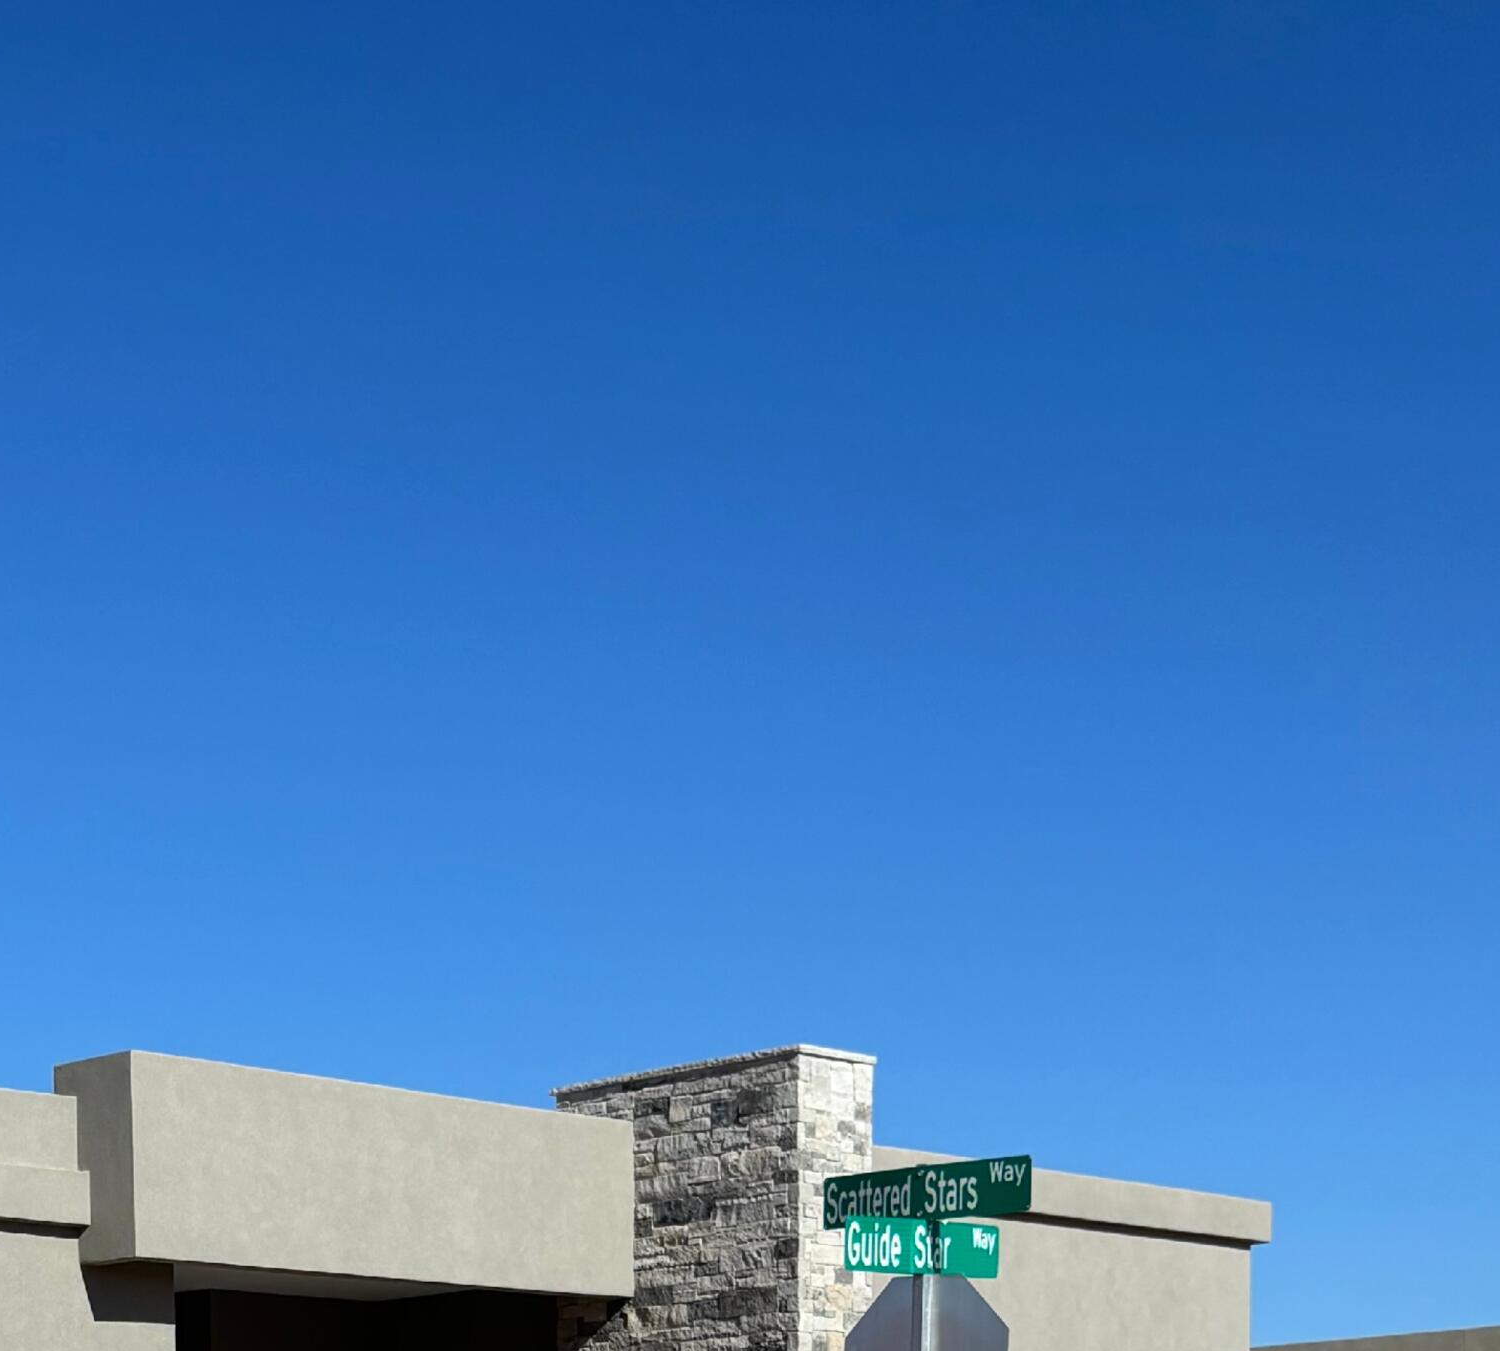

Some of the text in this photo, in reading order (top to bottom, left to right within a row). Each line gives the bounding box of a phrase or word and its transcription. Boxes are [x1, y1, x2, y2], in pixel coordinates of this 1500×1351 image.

[826, 1161, 1027, 1224] Scattered Stars Way
[847, 1221, 997, 1269] Guide Star Way
